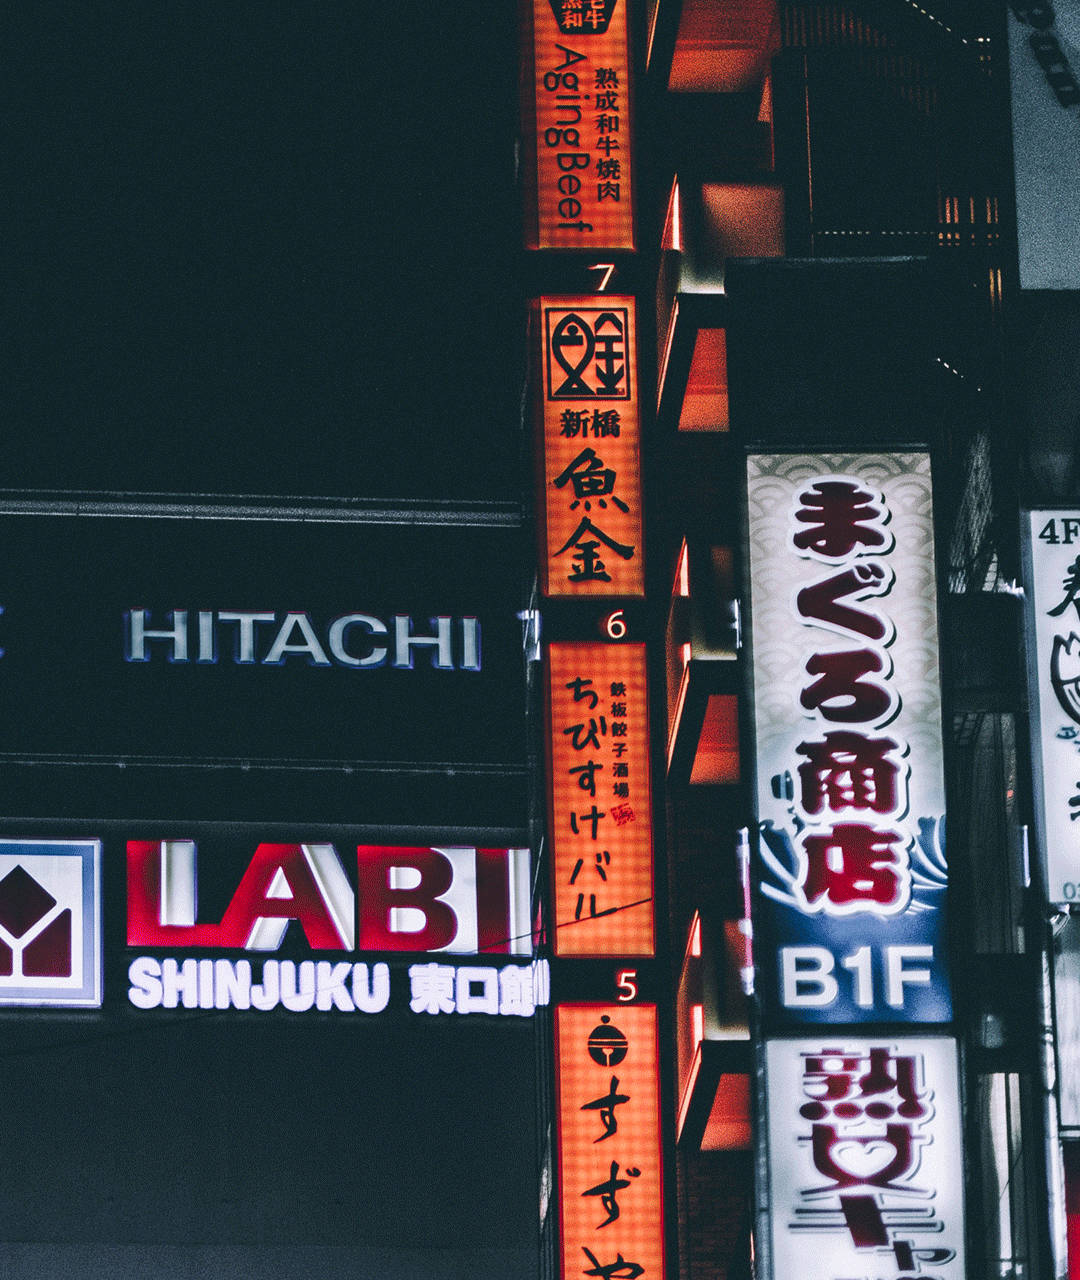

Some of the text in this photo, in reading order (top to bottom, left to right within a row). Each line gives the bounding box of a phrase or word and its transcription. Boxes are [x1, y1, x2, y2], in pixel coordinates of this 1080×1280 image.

[594, 67, 621, 202] 熟成和牛焼肉
[587, 264, 616, 291] 7
[559, 408, 621, 440] 新橋
[553, 446, 635, 583] 魚金
[124, 607, 482, 671] HITACHI
[606, 611, 626, 639] 6
[790, 478, 907, 912] まぐろ商店
[609, 681, 630, 799] 鉄板餃子酒場
[563, 676, 617, 920] ちびすけバル
[126, 839, 533, 957] LABI
[127, 955, 392, 1014] SHINJUKU
[617, 971, 637, 1001] 5
[780, 945, 934, 1009] B1F
